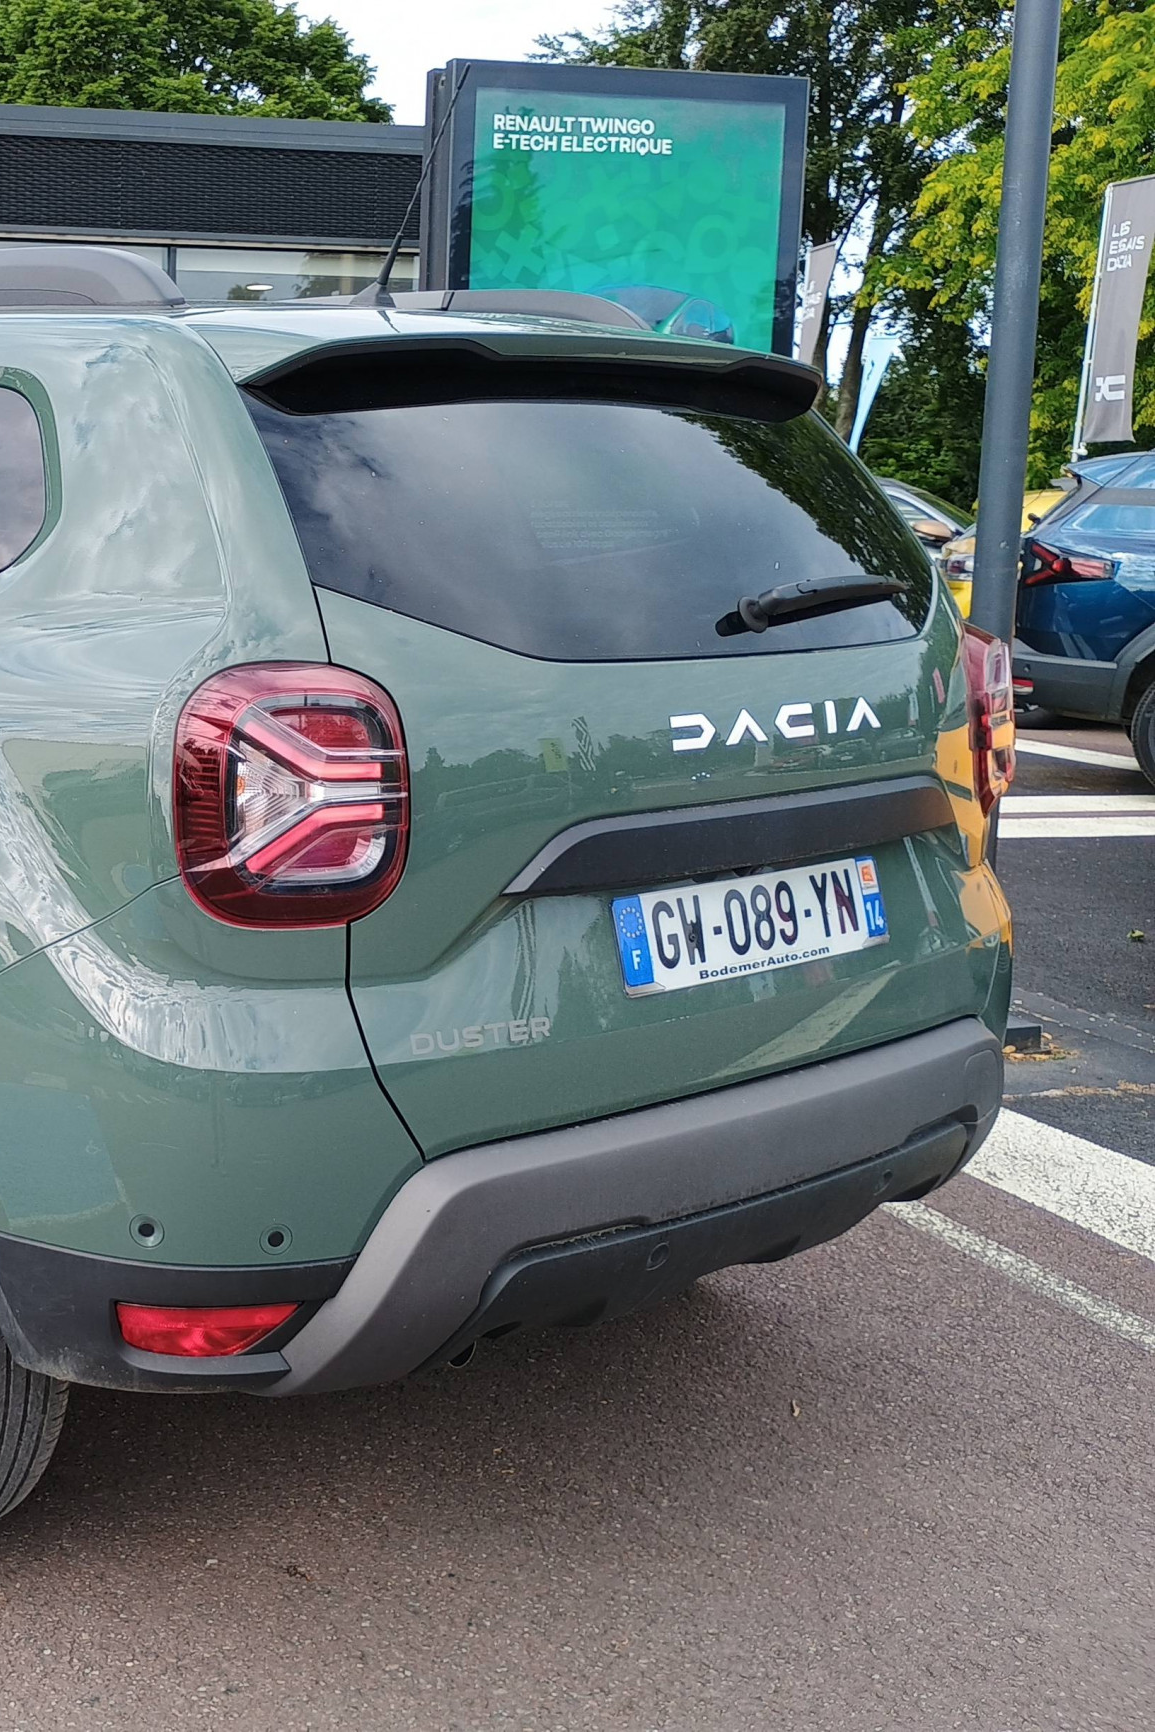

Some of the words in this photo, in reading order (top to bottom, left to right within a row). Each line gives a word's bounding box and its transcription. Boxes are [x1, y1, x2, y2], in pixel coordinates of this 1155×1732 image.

[493, 114, 577, 133] RENAULT
[578, 117, 655, 136] TWINGO
[493, 133, 557, 152] E-TECH
[561, 135, 673, 157] ELECTRIQUE
[668, 695, 882, 752] DACIA
[650, 868, 860, 970] GW-089-YN
[865, 899, 885, 931] 14
[631, 949, 642, 971] F
[699, 945, 830, 980] BodemerAuto.com
[409, 1016, 552, 1056] DUSTER
